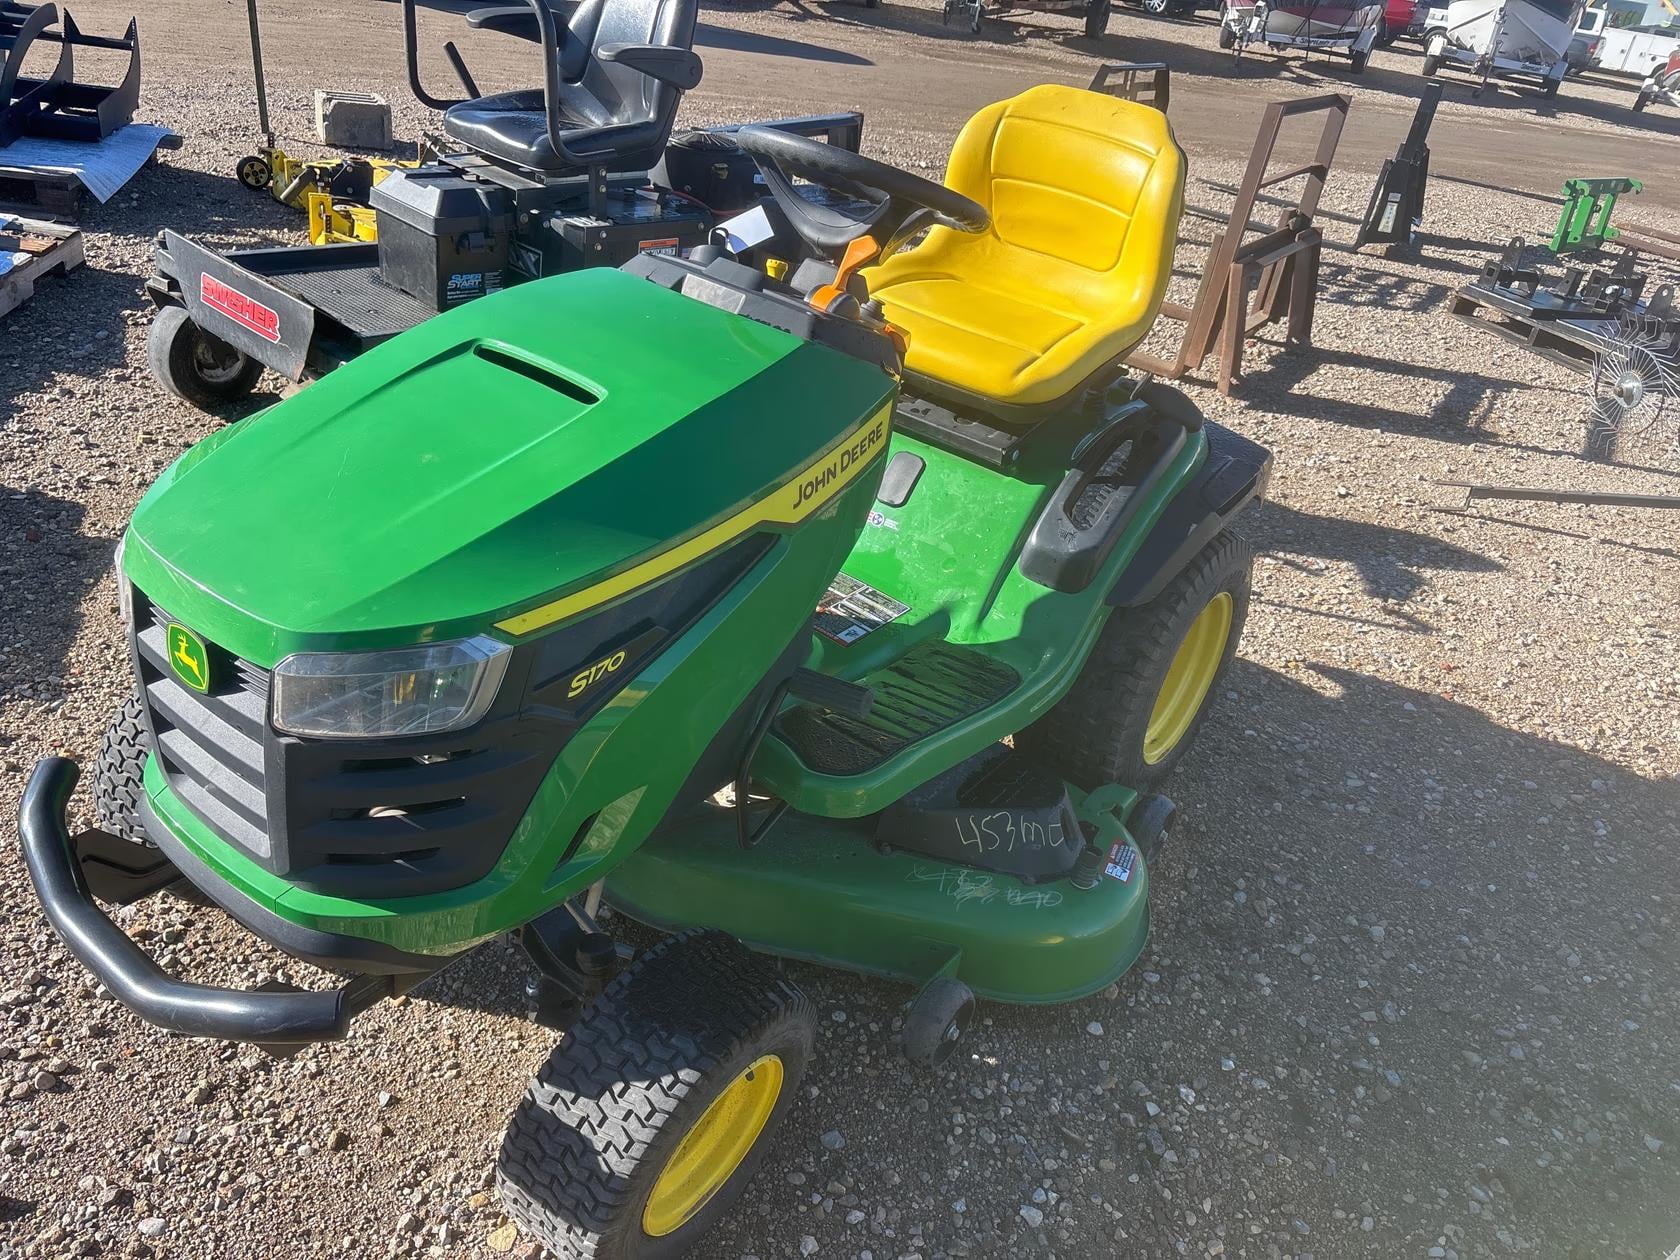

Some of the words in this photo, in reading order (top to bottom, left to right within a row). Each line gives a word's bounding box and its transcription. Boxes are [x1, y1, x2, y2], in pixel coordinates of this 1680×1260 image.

[792, 462, 838, 510] JOHN
[840, 420, 884, 473] DEERE
[567, 651, 626, 698] S170
